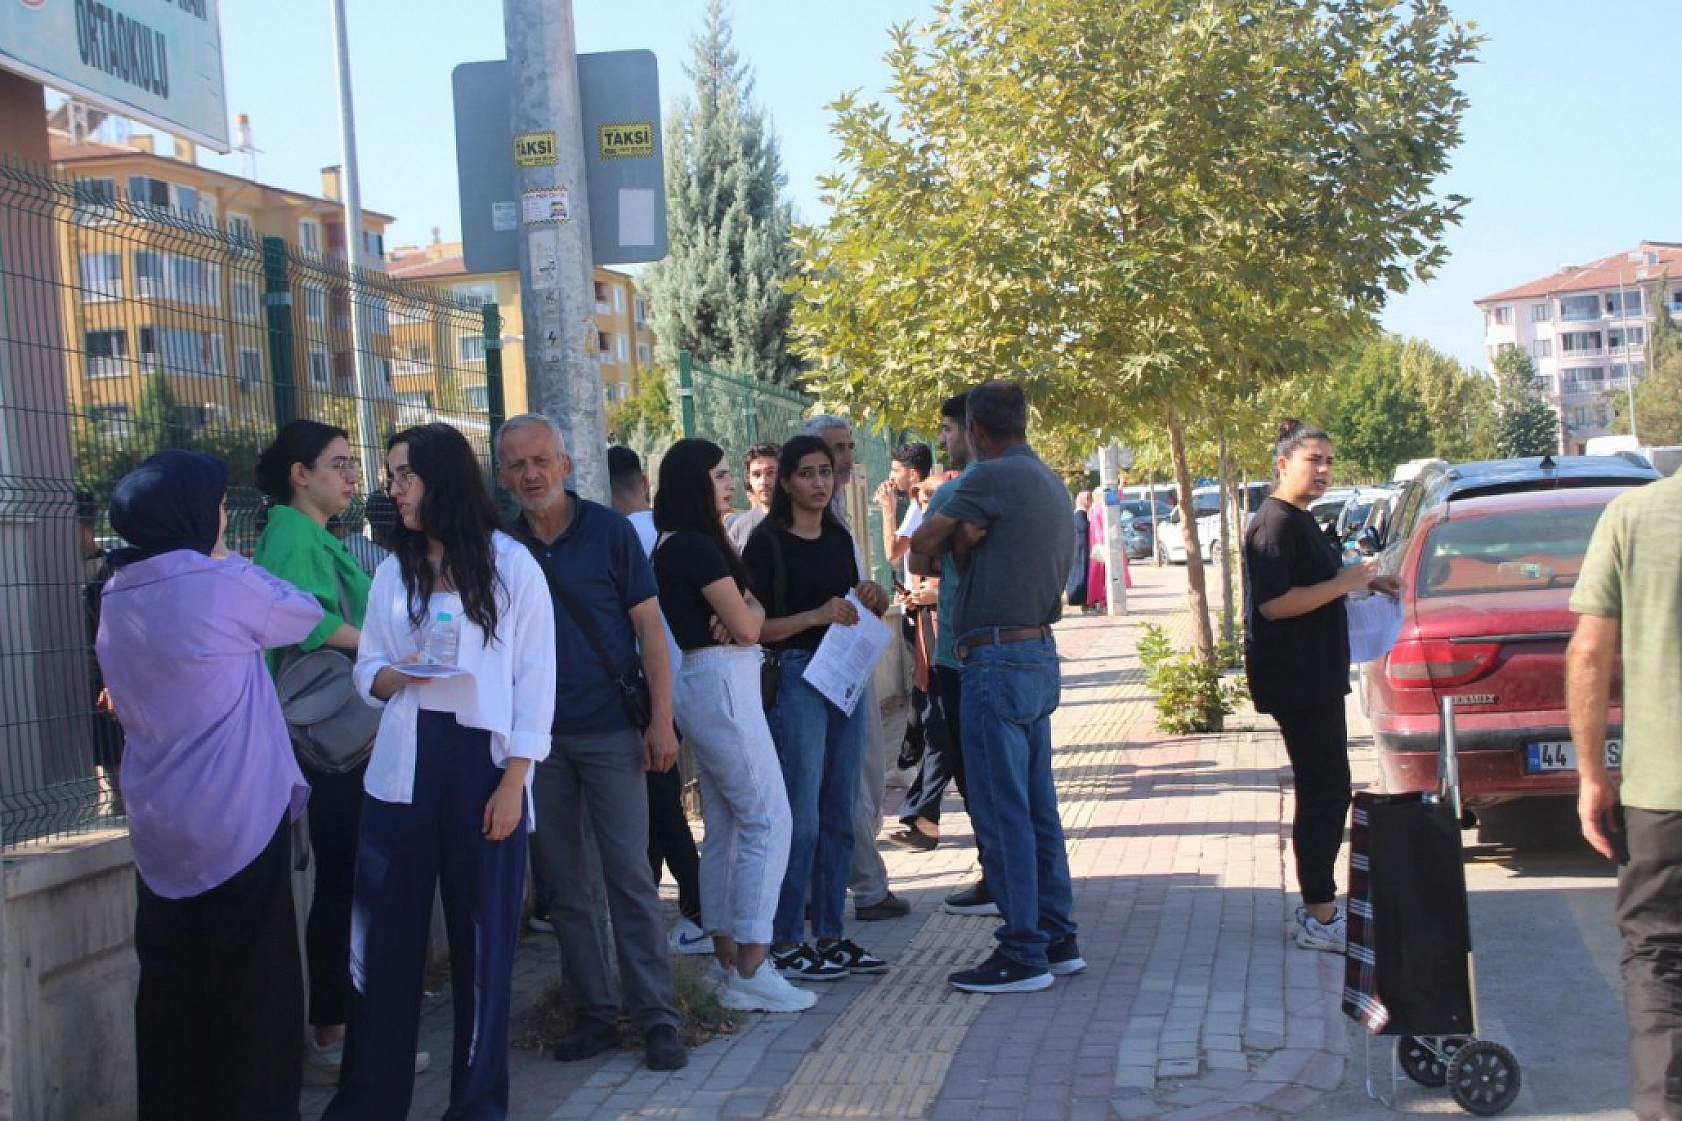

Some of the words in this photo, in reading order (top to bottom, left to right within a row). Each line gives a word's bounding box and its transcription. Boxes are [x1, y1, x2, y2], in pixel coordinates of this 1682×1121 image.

[74, 0, 169, 99] ORTAOKULU
[605, 127, 648, 146] TAKSİ
[1542, 743, 1567, 767] 44
